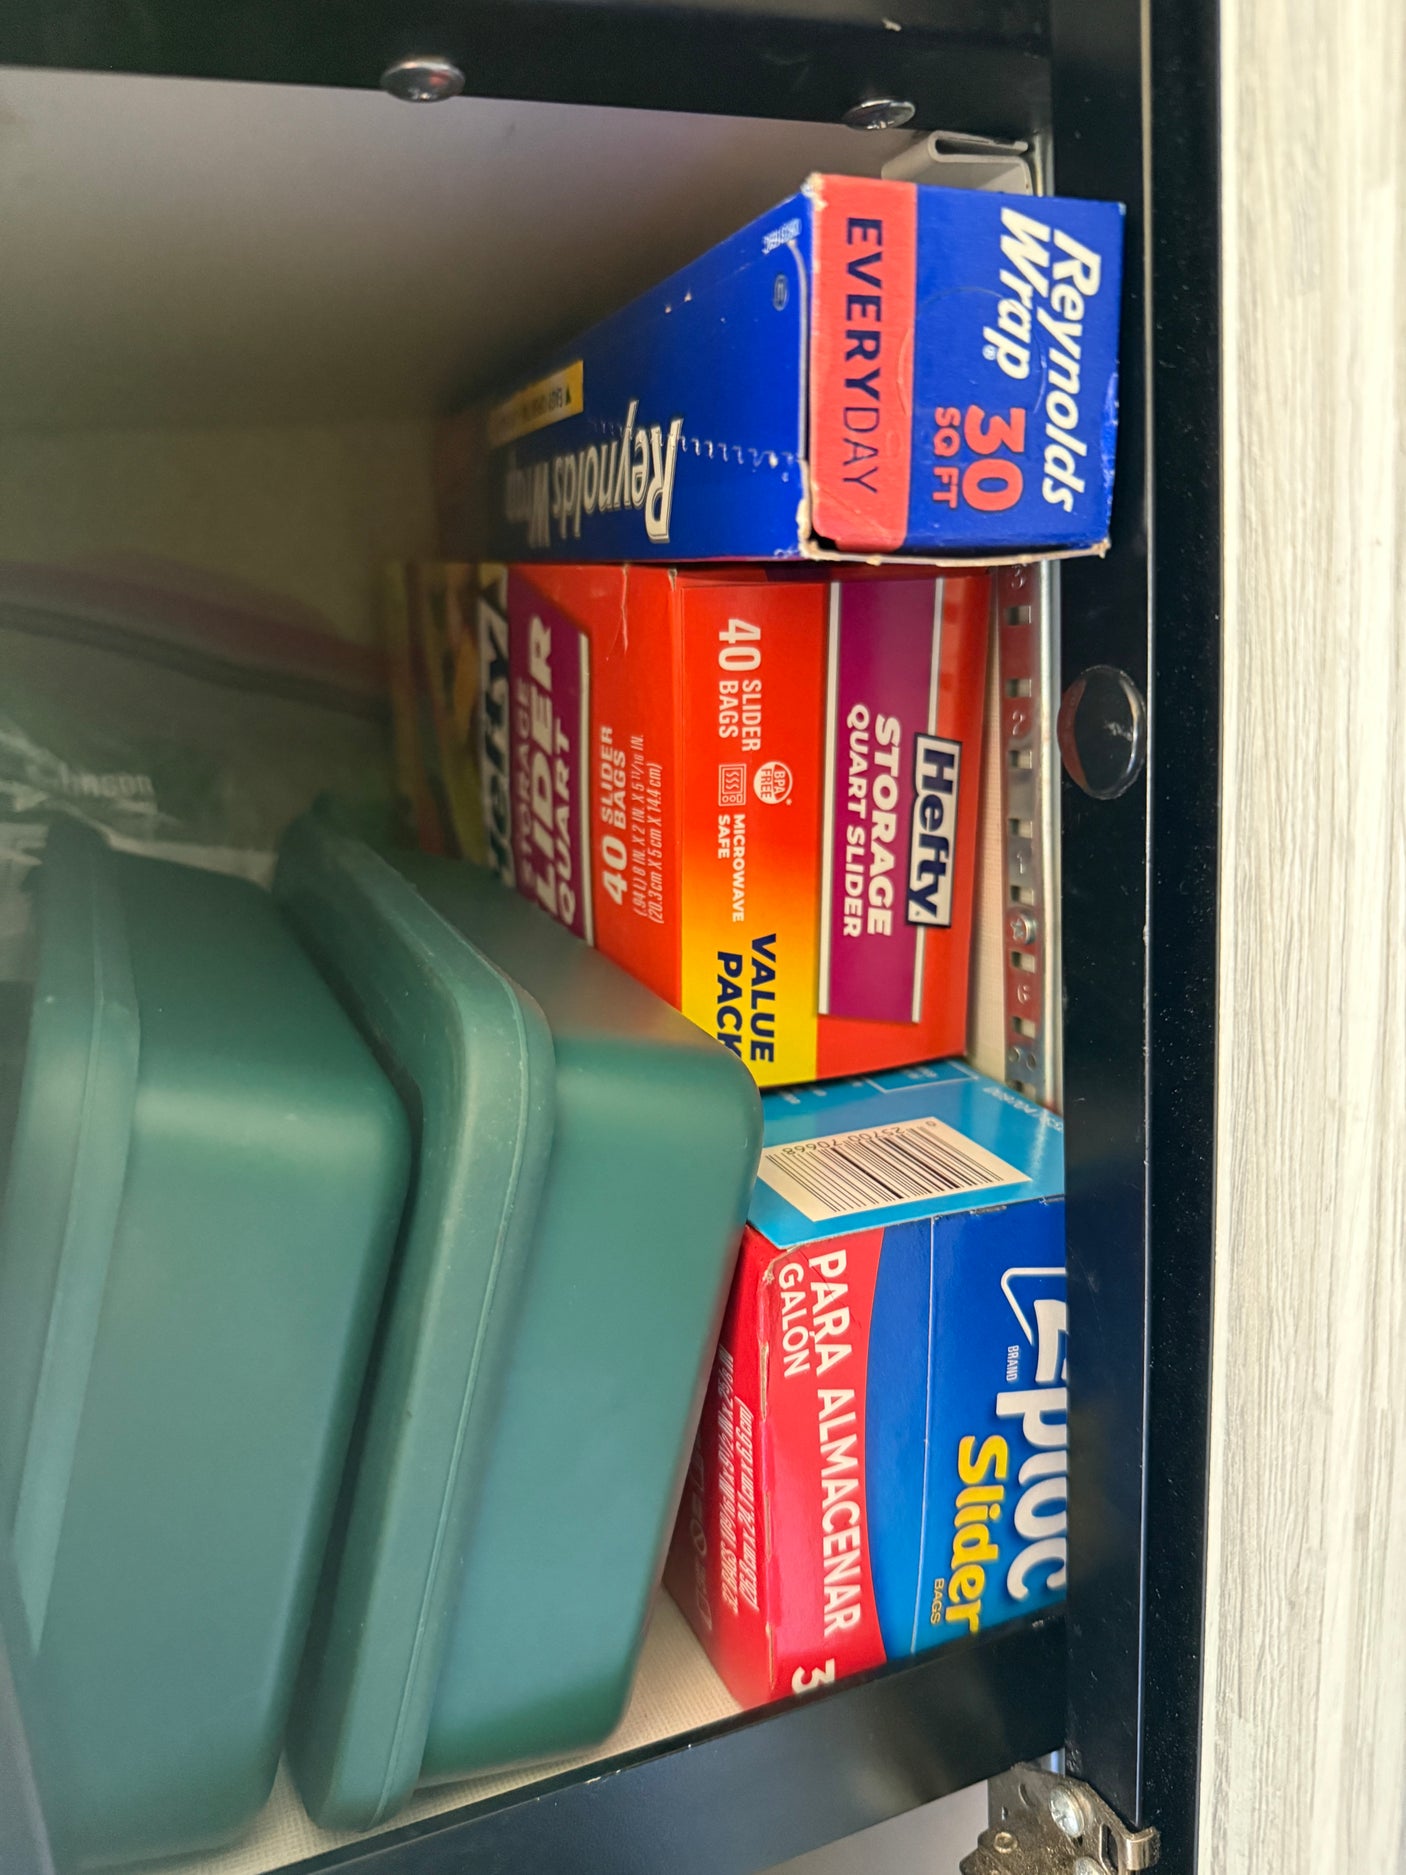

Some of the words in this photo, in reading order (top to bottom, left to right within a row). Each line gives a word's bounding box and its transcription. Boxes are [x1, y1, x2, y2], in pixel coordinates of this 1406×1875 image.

[982, 208, 1051, 380] Wrap
[842, 217, 884, 495] EVERYDAY
[1037, 229, 1101, 512] Reynolds
[552, 400, 685, 544] Reynolds
[932, 467, 960, 508] FT
[933, 406, 961, 457] SQ
[961, 405, 1026, 512] 30
[718, 618, 762, 672] 40
[529, 615, 558, 916] LIDER
[718, 680, 739, 738] BAGS
[742, 679, 762, 752] SLIDER
[846, 704, 870, 818] QUART
[555, 717, 576, 926] QUART
[600, 726, 614, 824] SLIDER
[613, 750, 627, 830] BAGS
[760, 768, 773, 800] FREE
[867, 714, 901, 936] STORAGE
[602, 835, 628, 906] 40
[718, 815, 731, 859] SAFE
[732, 814, 746, 922] MICROWAVE
[843, 825, 865, 938] SLIDER
[908, 748, 955, 918] Hefty
[750, 933, 776, 1063] VALUE
[778, 1262, 815, 1379] GALÓN
[808, 1249, 853, 1376] PARA
[1006, 1344, 1020, 1382] BRAND
[816, 1388, 862, 1638] ALMACENAR
[946, 1434, 1009, 1633] Slider
[930, 1578, 945, 1625] BAGS
